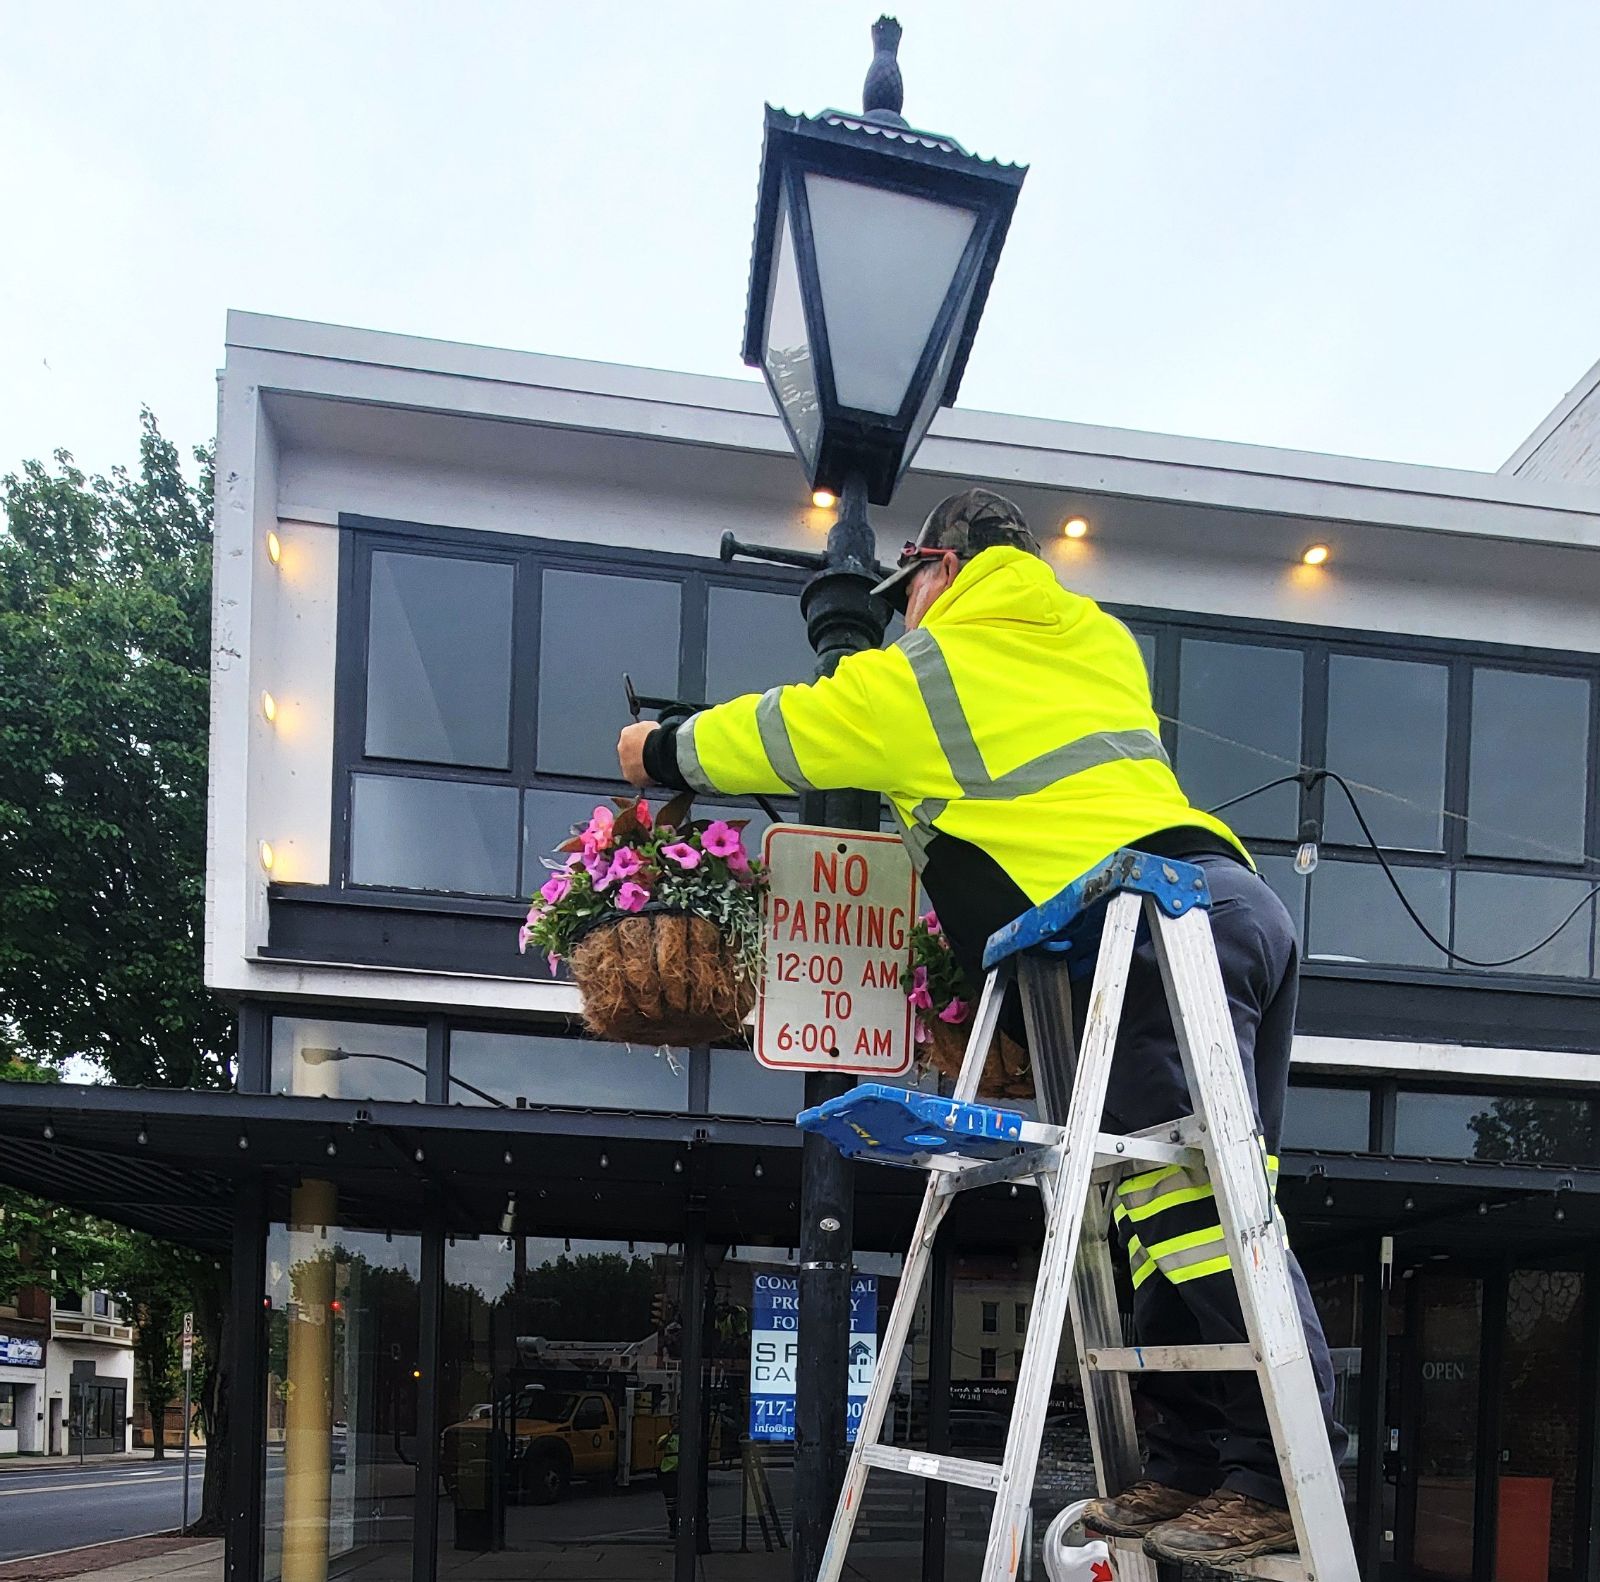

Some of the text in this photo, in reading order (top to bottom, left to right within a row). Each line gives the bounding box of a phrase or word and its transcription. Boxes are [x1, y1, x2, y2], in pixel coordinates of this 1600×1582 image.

[813, 851, 868, 896] NO
[773, 898, 905, 951] PARKING
[777, 953, 898, 990] 12:00 AM
[822, 990, 852, 1020] TO
[777, 1022, 892, 1057] 6:00 AM
[772, 1316, 799, 1330] FO
[1422, 1362, 1464, 1380] OPEN
